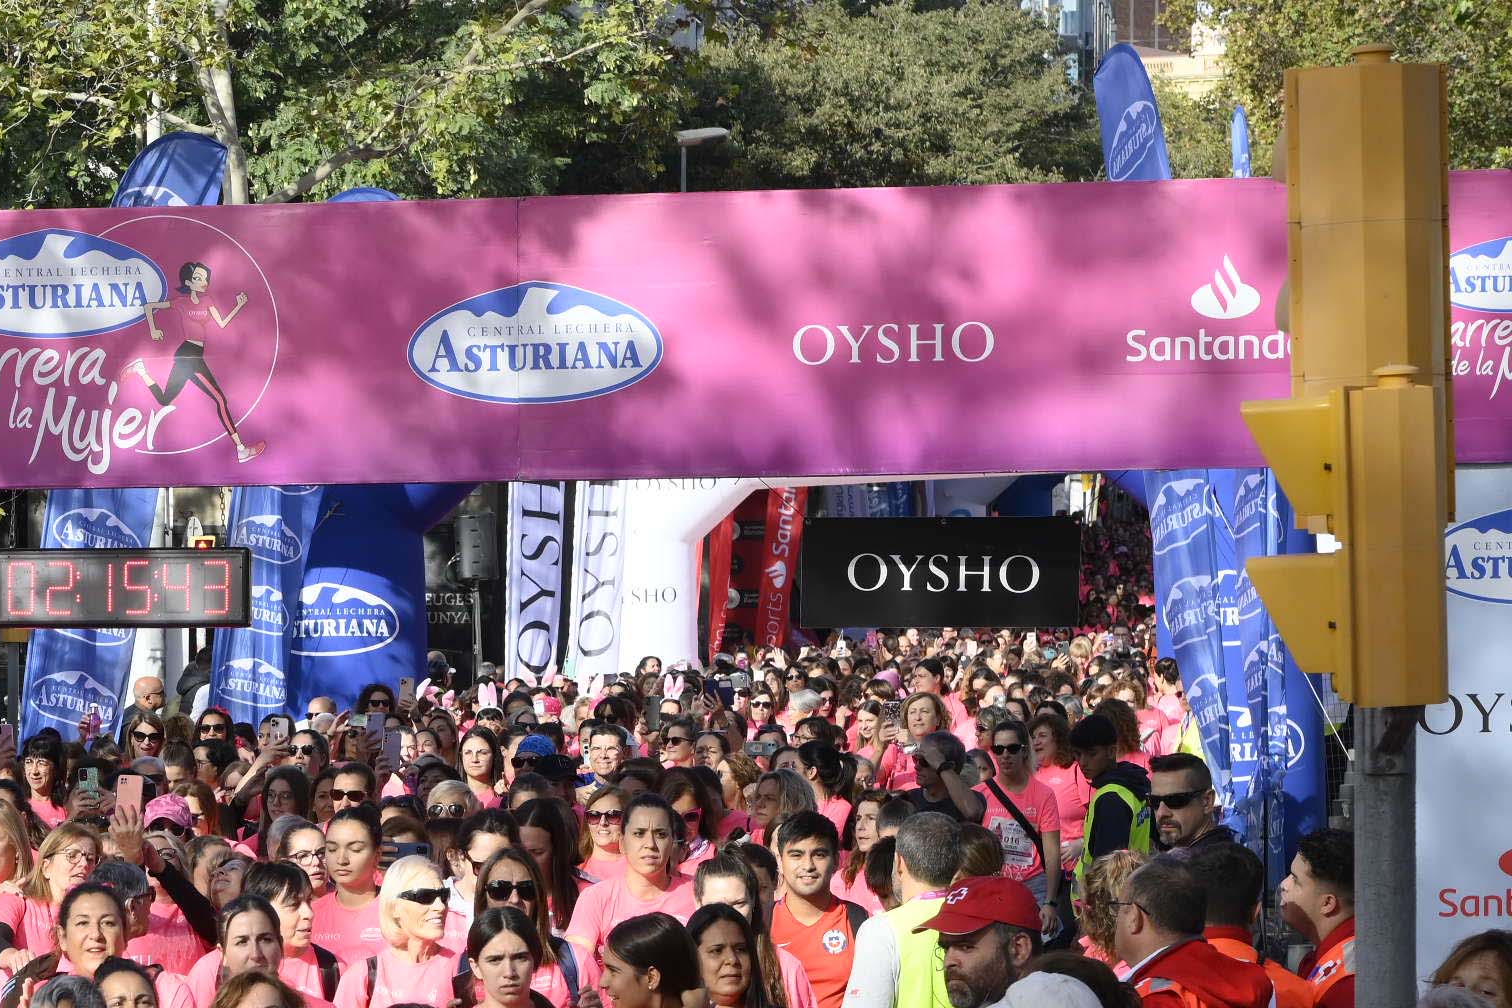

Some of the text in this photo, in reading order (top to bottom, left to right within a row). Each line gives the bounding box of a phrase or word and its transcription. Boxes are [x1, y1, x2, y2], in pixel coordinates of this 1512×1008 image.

[70, 265, 143, 278] LECHERA
[1449, 266, 1512, 294] ASTU
[1466, 263, 1512, 271] CENTRA
[466, 323, 636, 337] CENTRAL LECHERA
[792, 321, 996, 367] OYSHO
[1450, 318, 1512, 348] arre
[426, 328, 642, 374] ASTURIANA
[1126, 329, 1292, 363] Santand
[1475, 349, 1494, 376] la
[8, 389, 33, 430] la
[29, 380, 177, 475] Mujer
[516, 482, 561, 677] OYSH
[578, 482, 620, 657] OYSH
[847, 553, 1041, 595] OYSHO
[7, 561, 230, 616] 02:15:43
[425, 592, 474, 606] EUGES
[631, 586, 678, 605] SHO
[291, 617, 390, 639] STURIANA
[427, 611, 473, 625] UNYA
[1418, 692, 1512, 736] OY
[1438, 888, 1512, 918] Sant
